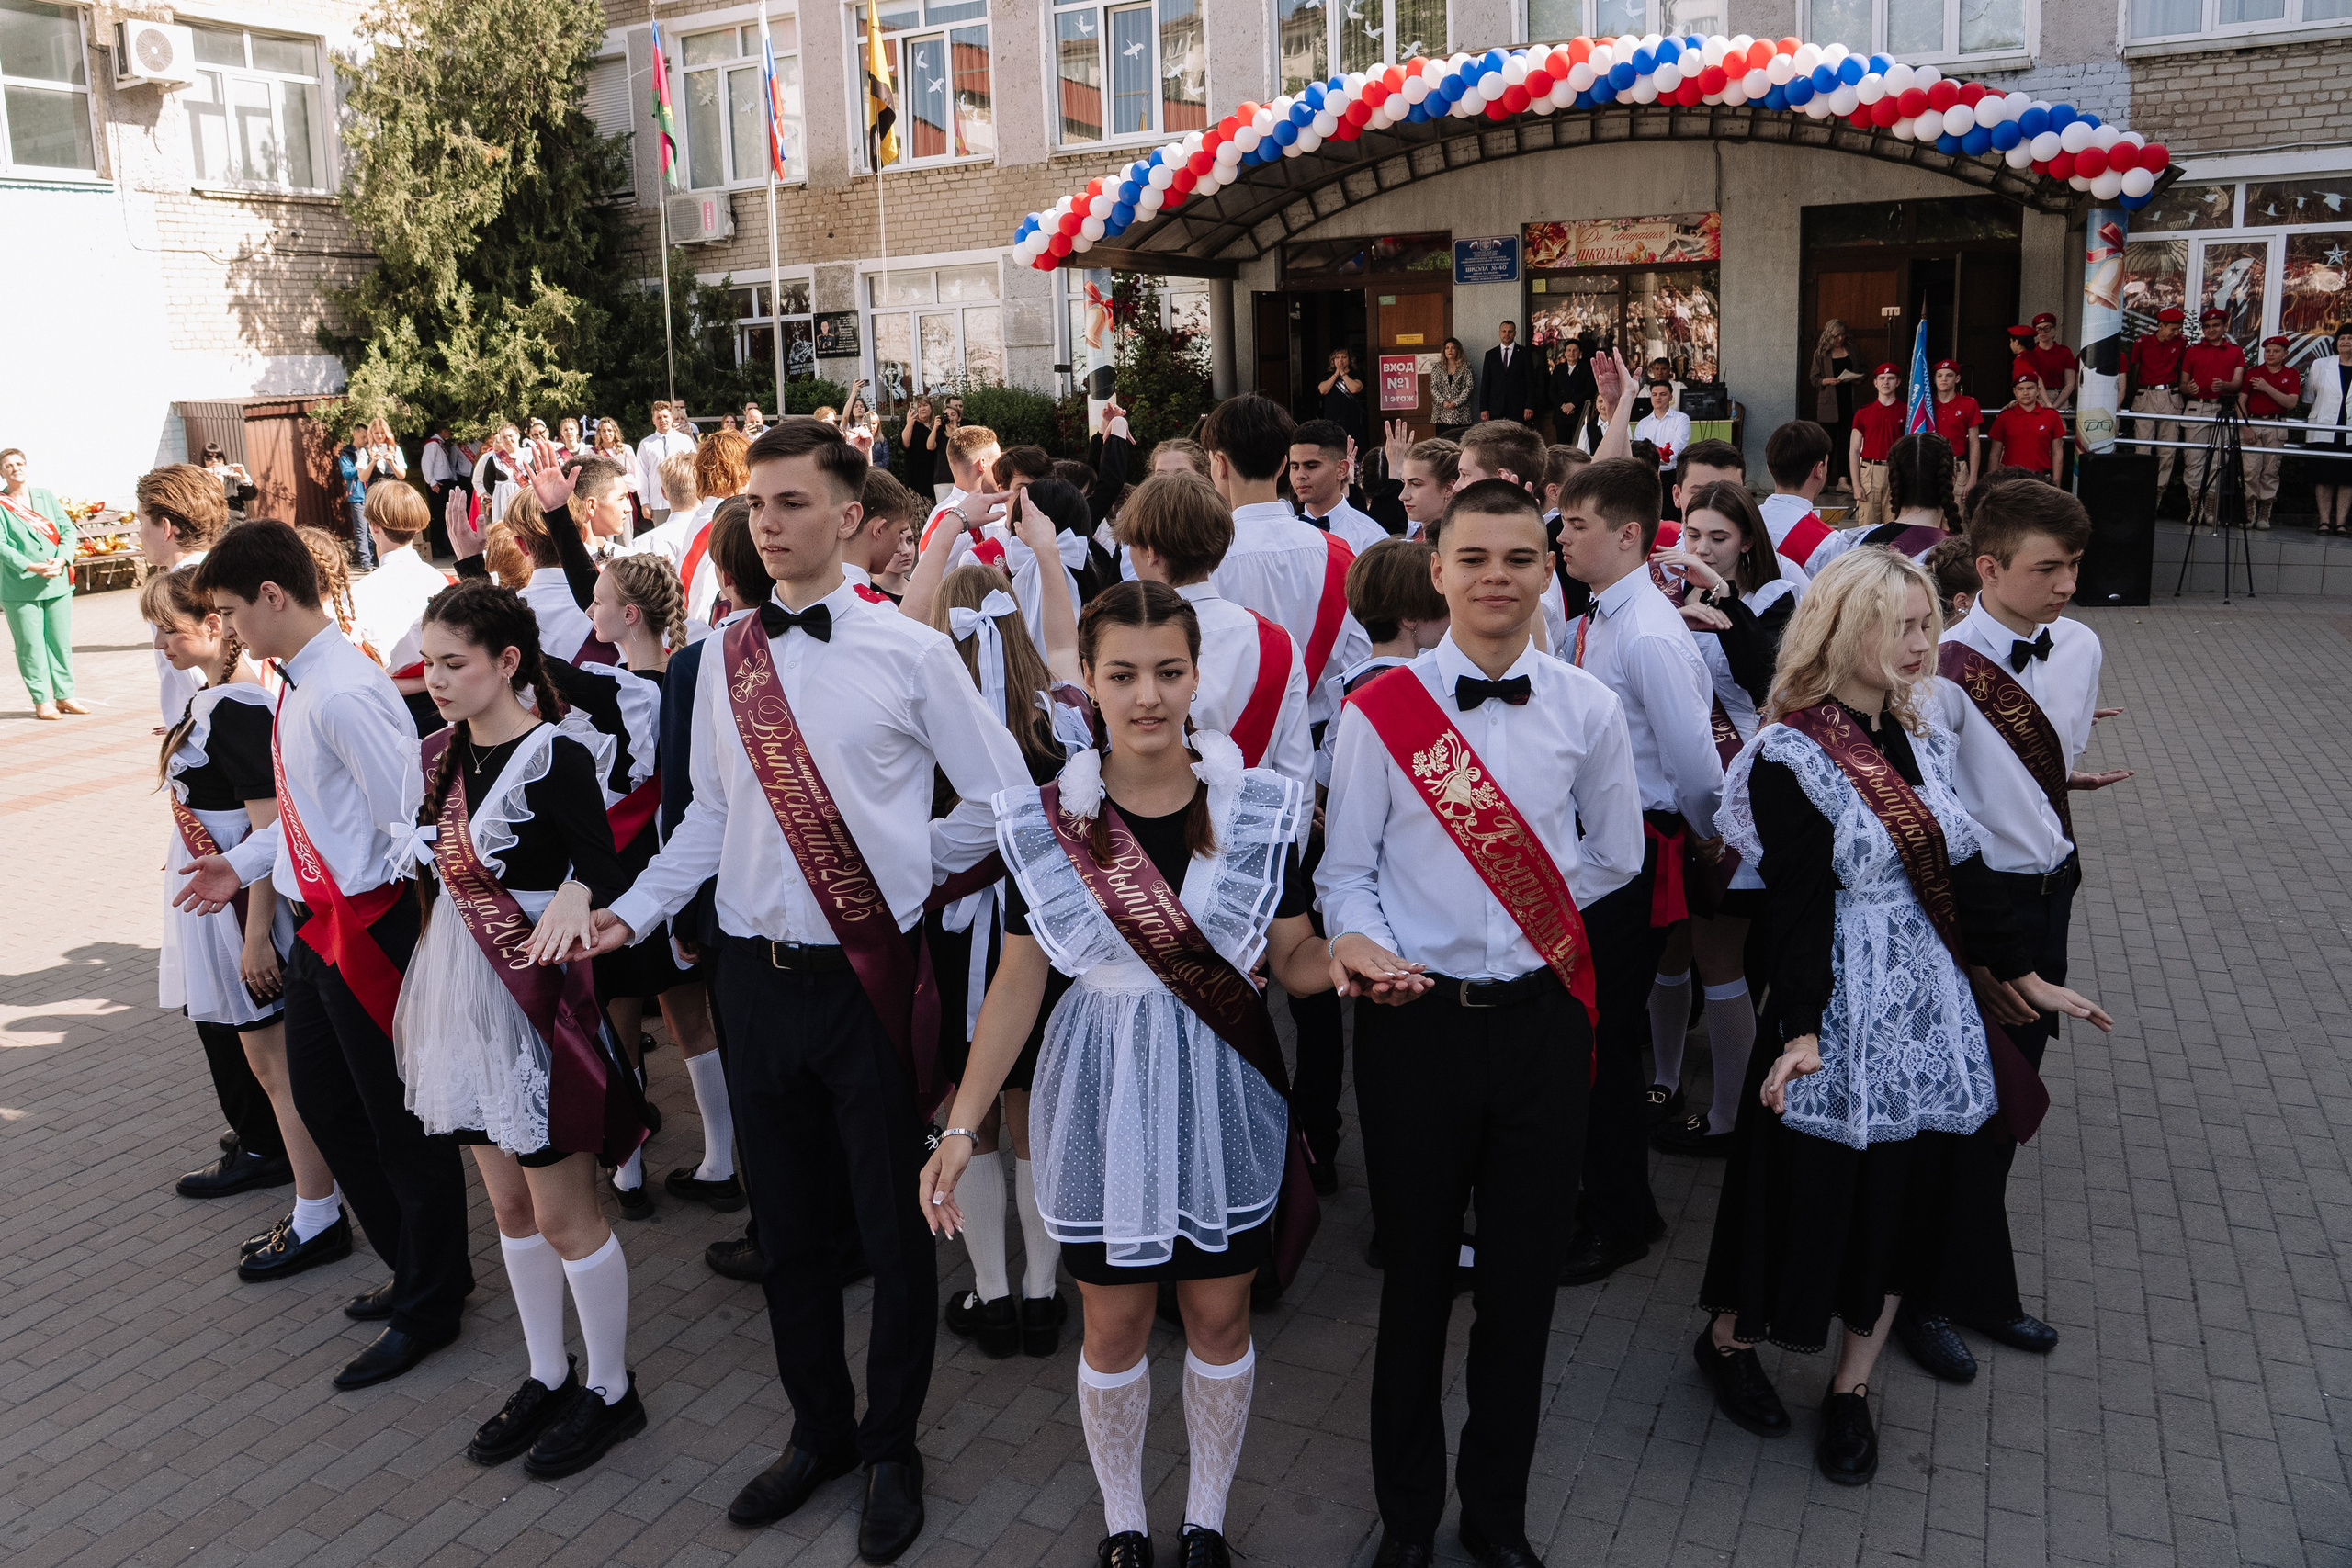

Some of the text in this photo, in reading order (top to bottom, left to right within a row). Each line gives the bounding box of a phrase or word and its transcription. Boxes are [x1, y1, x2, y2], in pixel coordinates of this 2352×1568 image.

[1577, 228, 1604, 244] До
[1577, 247, 1626, 261] ШКОЛА!
[1383, 362, 1415, 373] ВХОД
[1386, 377, 1409, 389] №1
[735, 714, 743, 722] 11
[746, 745, 762, 771] класс
[747, 694, 885, 922] Выпускник 2025
[791, 740, 857, 859] Самарский Дмитрий
[1845, 742, 1936, 886] Выпускница
[1892, 775, 1929, 821] Холодова
[457, 808, 476, 864] Ивановская
[767, 792, 793, 830] МАОУ
[787, 829, 805, 862] СОШ
[298, 840, 326, 884] 2025
[1068, 853, 1080, 863] 11
[1090, 886, 1110, 912] класс
[1149, 879, 1189, 933] Барабаш
[1464, 814, 1580, 972] Выпускник
[1087, 829, 1253, 1026] Выпускница 2025
